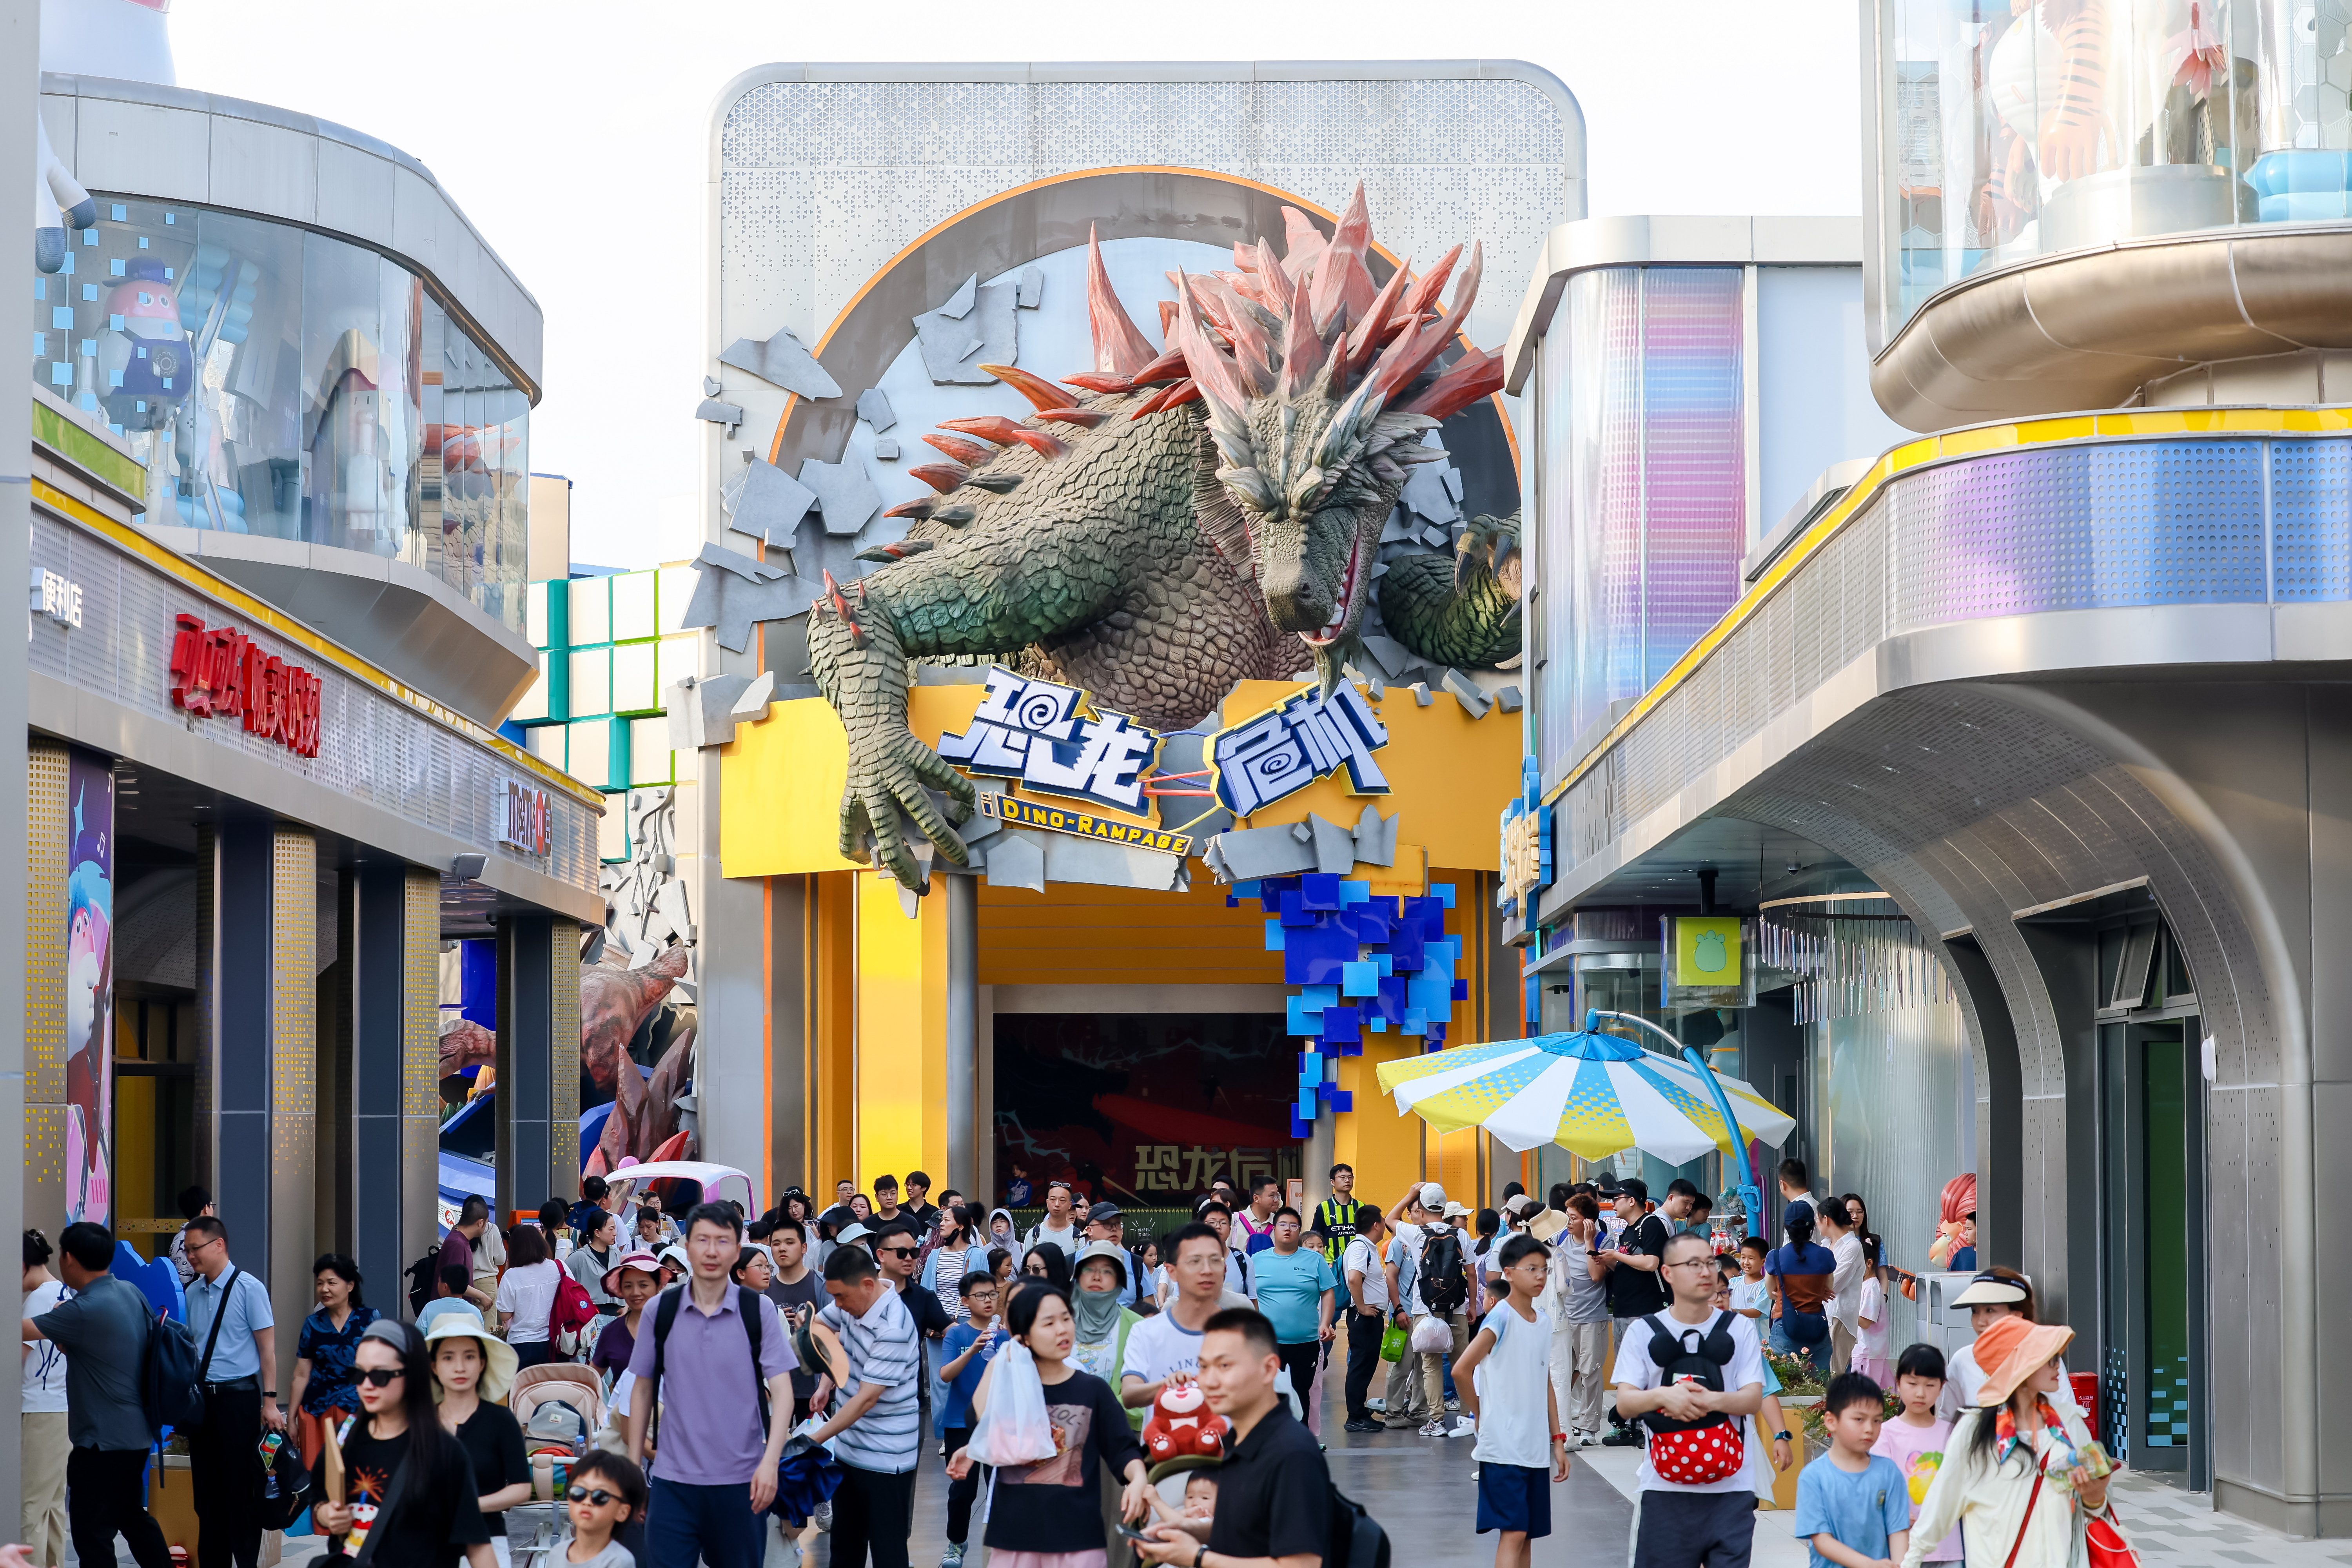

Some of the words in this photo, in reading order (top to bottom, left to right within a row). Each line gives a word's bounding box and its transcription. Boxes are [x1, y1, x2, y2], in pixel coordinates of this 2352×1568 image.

[41, 568, 82, 628] 便利店
[937, 669, 1154, 808] 恐龙
[1217, 677, 1390, 816] 危机
[1003, 798, 1186, 853] DINO-RAMPAGE
